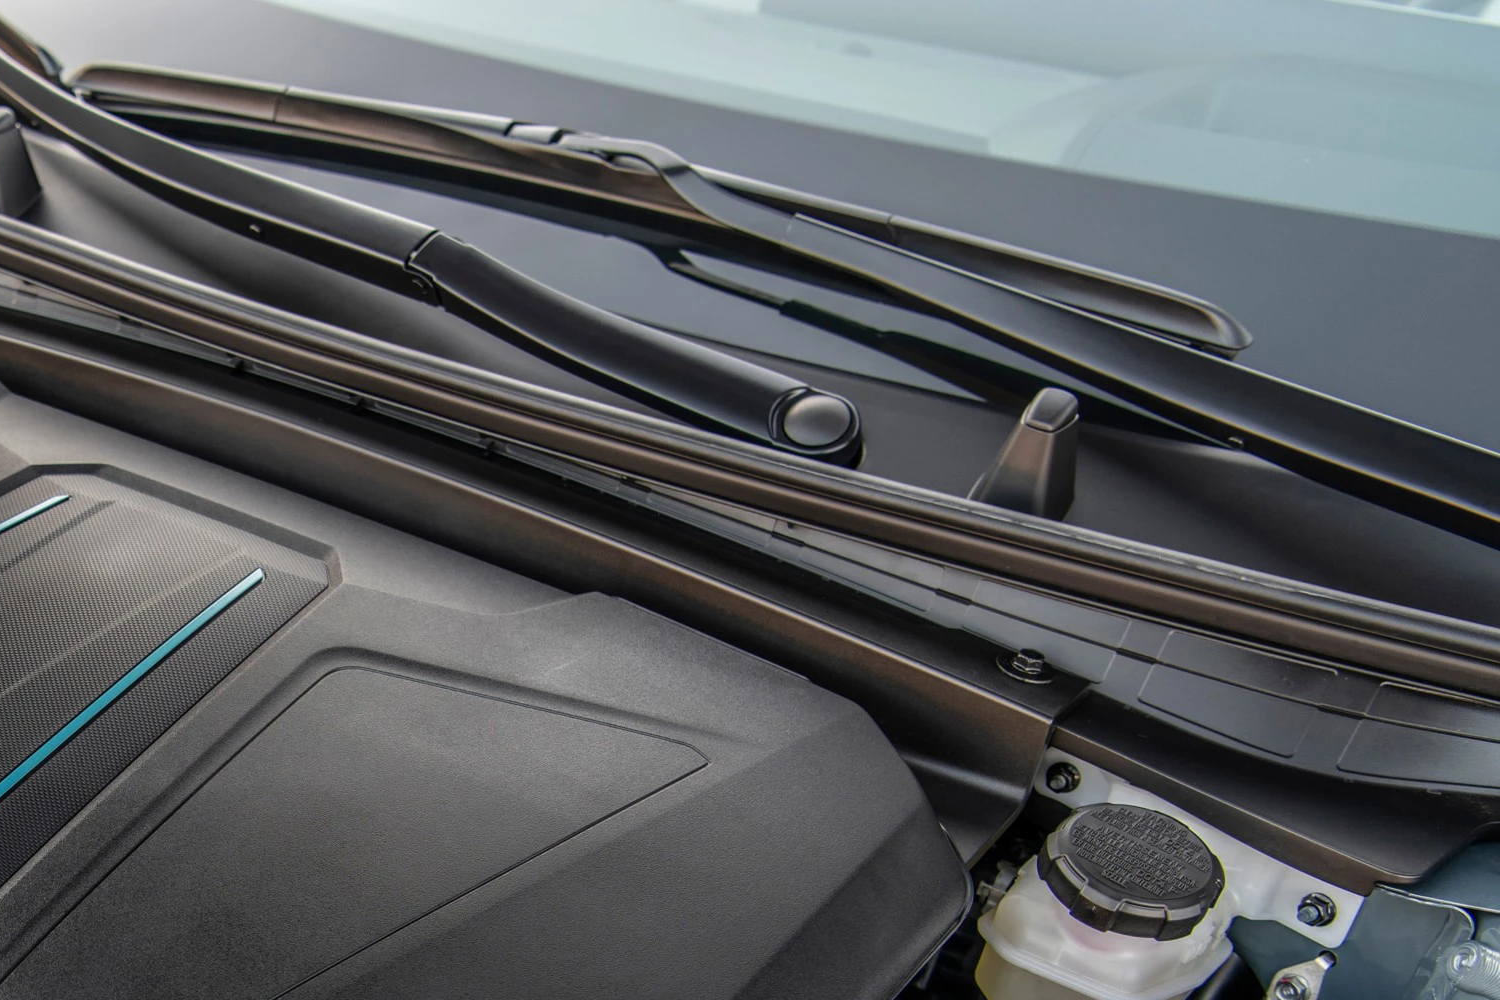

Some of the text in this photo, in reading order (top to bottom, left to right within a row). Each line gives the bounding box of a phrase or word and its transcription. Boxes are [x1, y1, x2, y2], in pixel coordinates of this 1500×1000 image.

[1142, 811, 1189, 837] WARNING
[1096, 824, 1186, 872] AVERTISSEMENT
[1105, 854, 1135, 872] LIQUIDE
